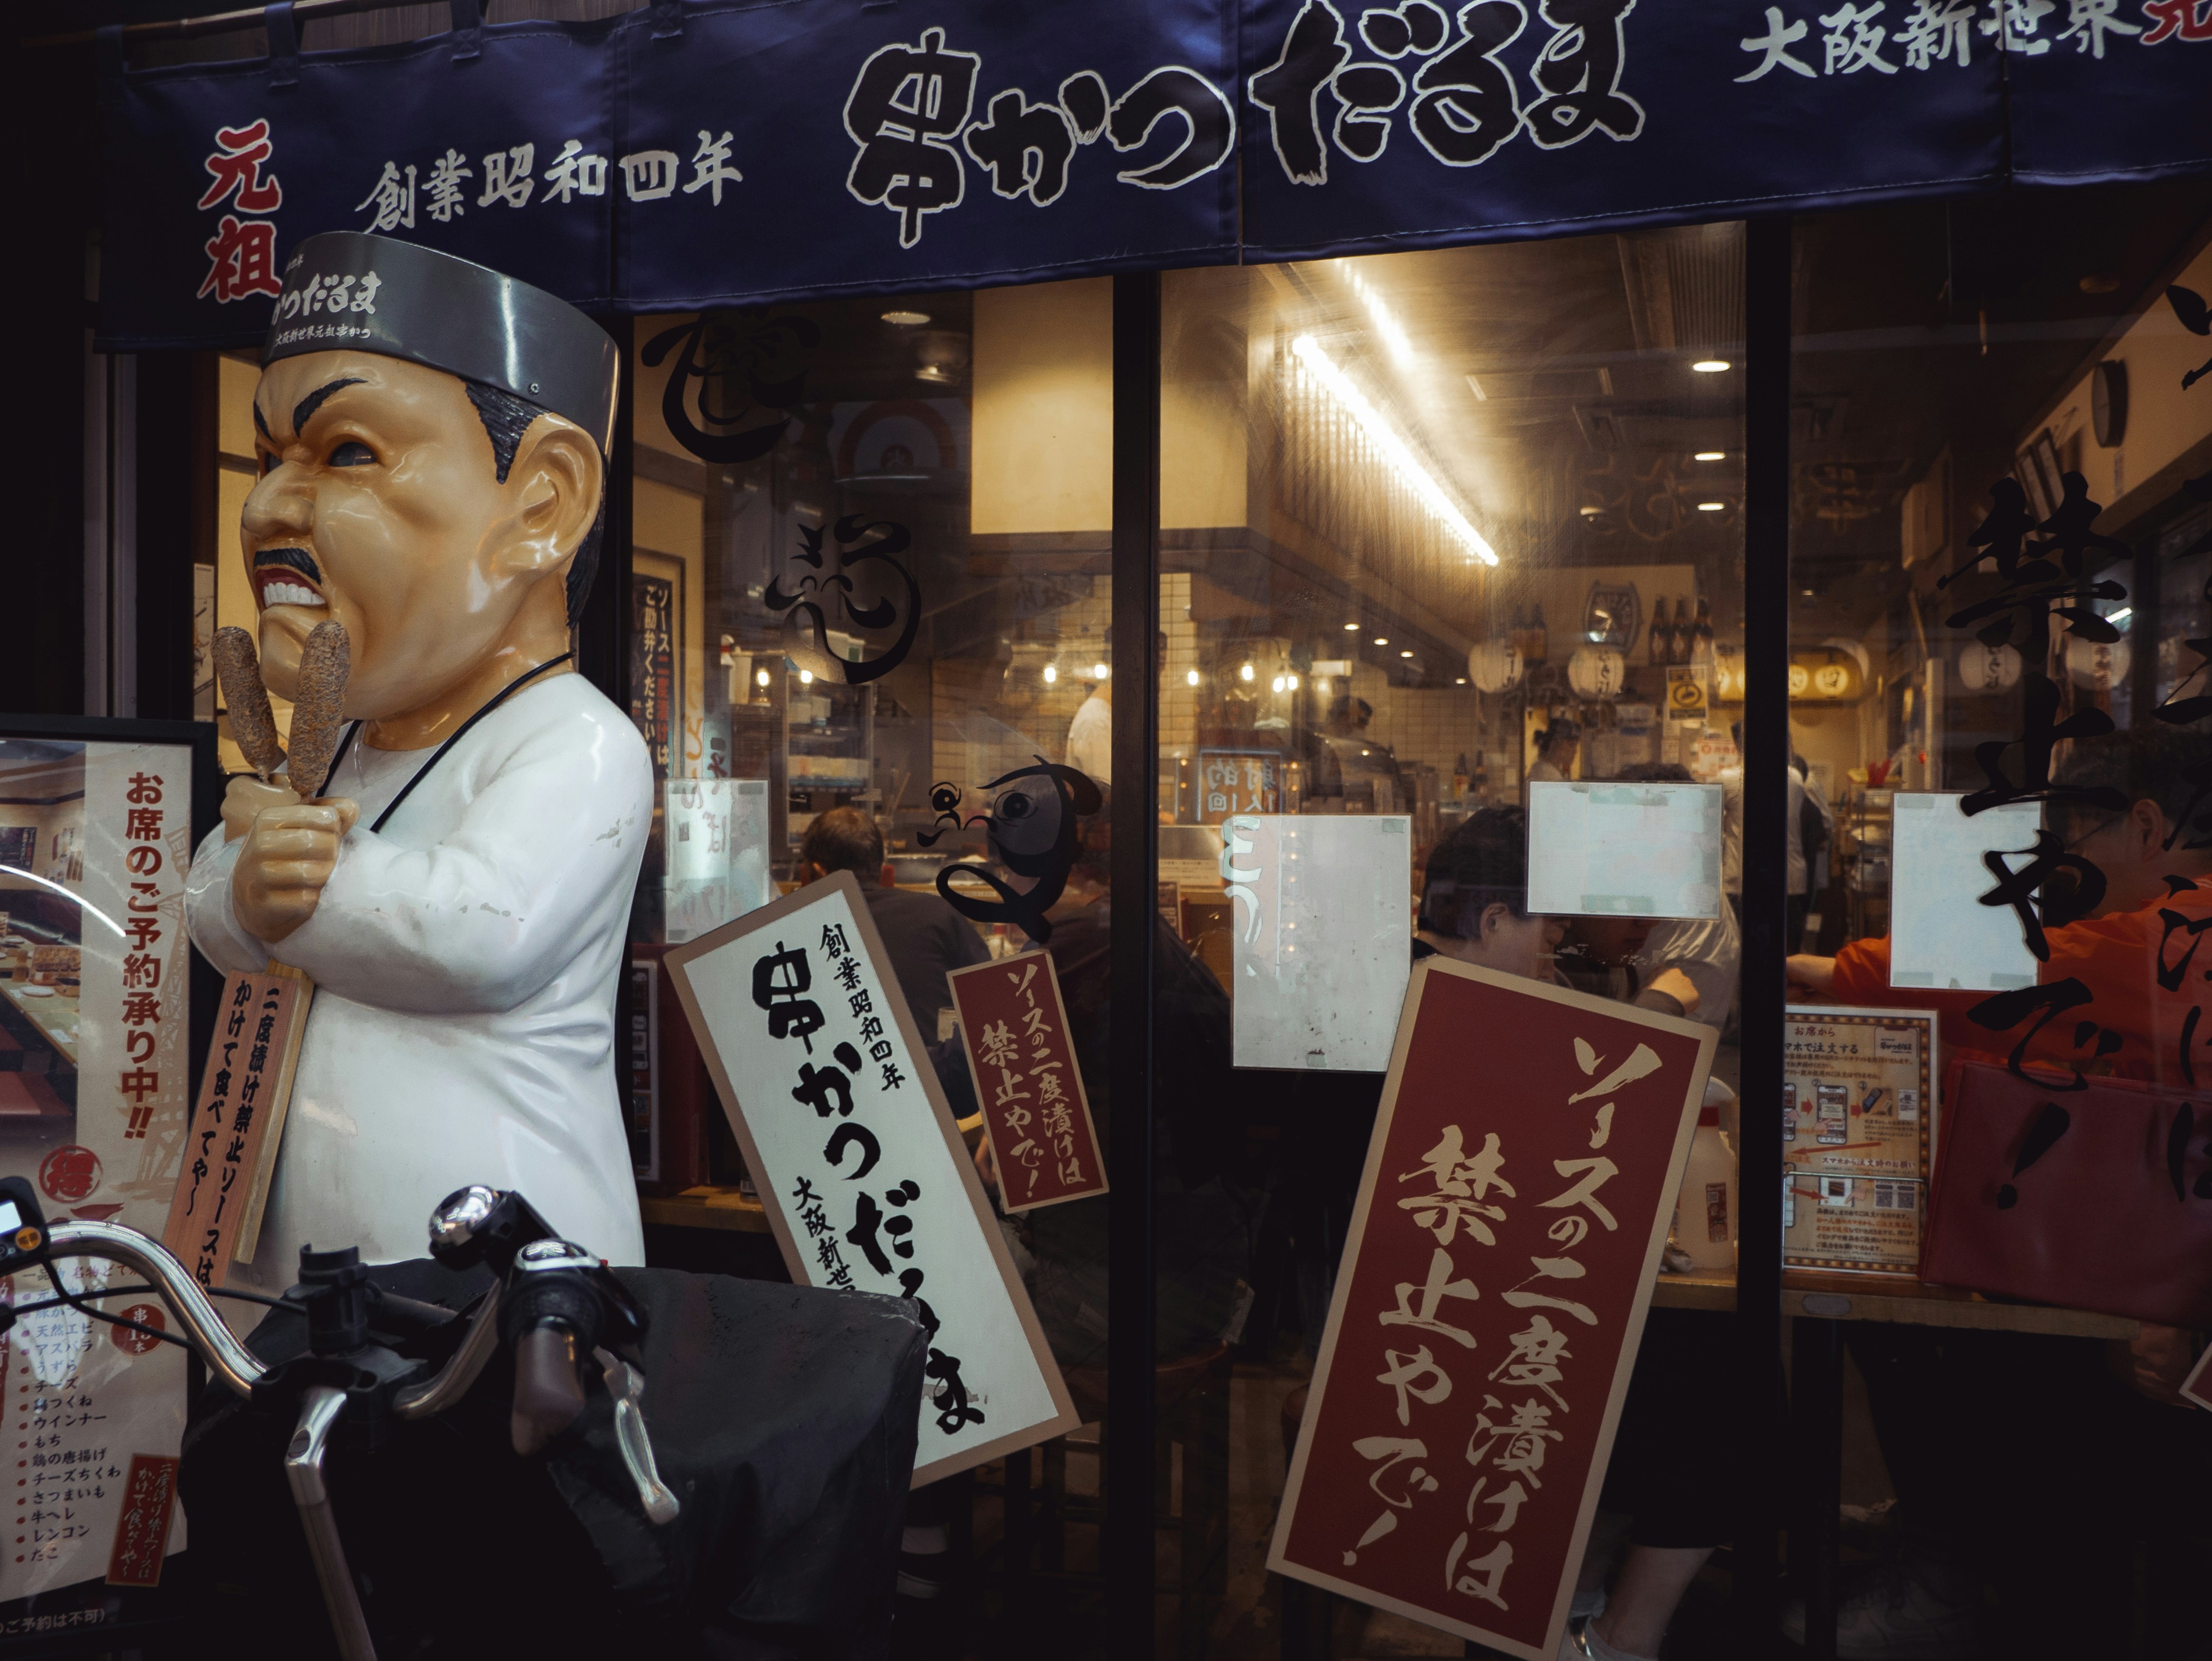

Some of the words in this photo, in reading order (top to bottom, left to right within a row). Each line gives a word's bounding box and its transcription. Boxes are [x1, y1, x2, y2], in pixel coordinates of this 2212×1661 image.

[843, 0, 1646, 249] 串かつだるま
[197, 117, 283, 305] 元祖
[355, 130, 743, 234] 創業昭和四年
[819, 922, 906, 1091] 創業昭和四年
[977, 1018, 1045, 1198] 禁止やで！
[1007, 963, 1087, 1187] ソースの二度漬けは
[792, 1176, 857, 1290] 大阪新世
[133, 1308, 148, 1324] 串
[1342, 1124, 1517, 1567] 禁止やで！
[1446, 1035, 1663, 1612] ソースの二度漬けは
[35, 1376, 78, 1392] チーズ
[33, 1465, 121, 1486] チーズちくわ
[33, 1485, 105, 1505] さつまいも
[35, 1434, 61, 1448] もち
[31, 1548, 58, 1562] たこ
[34, 1525, 90, 1543] レンコン
